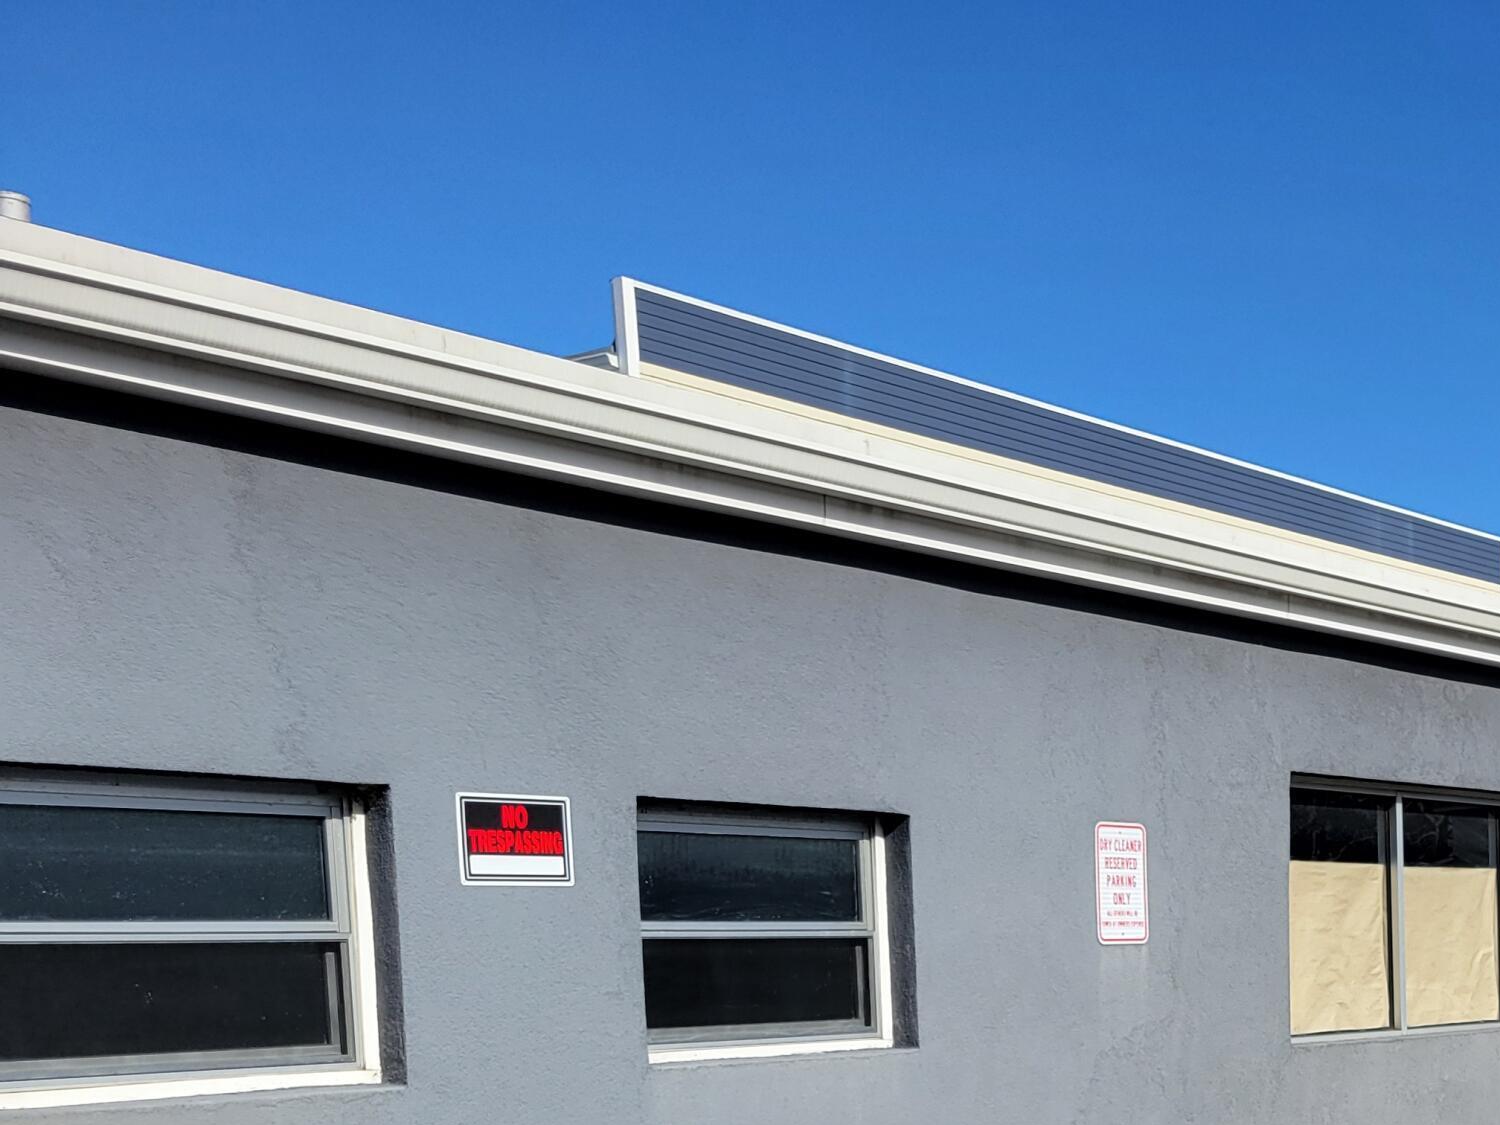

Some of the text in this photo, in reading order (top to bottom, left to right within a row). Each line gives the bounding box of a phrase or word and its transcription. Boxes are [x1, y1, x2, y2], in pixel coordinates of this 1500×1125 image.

[502, 804, 528, 829] NO
[467, 829, 564, 854] TRESPASSING
[1100, 838, 1142, 852] DRY CLEANER
[1104, 856, 1137, 870] RESERVED
[1106, 875, 1137, 888] PARKING
[1113, 892, 1131, 905] ONLY
